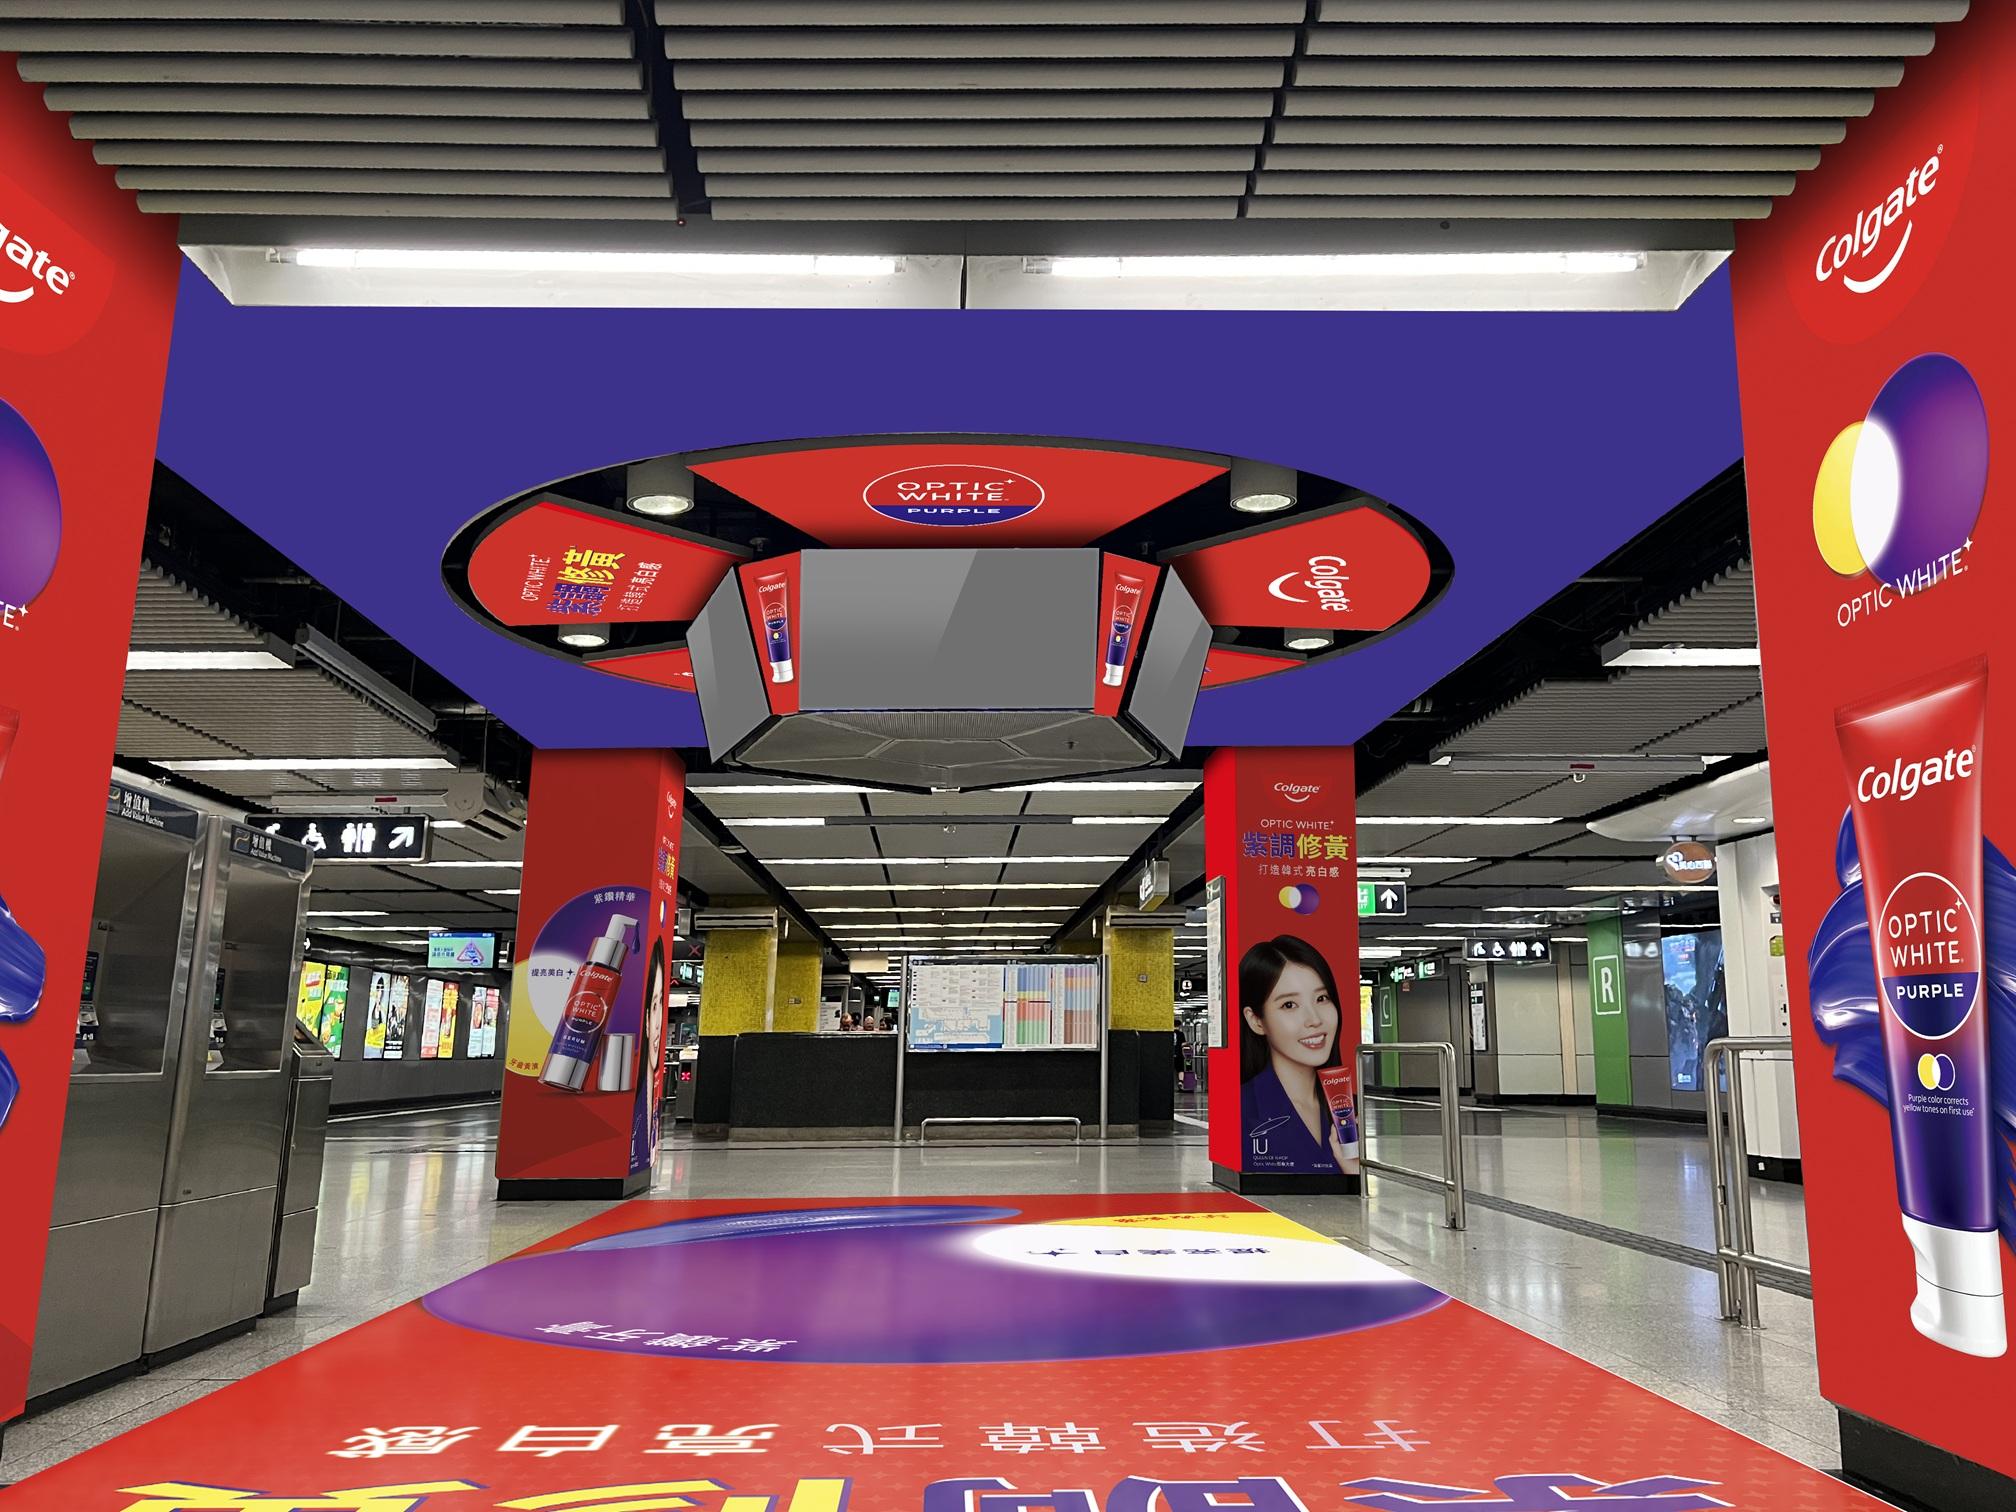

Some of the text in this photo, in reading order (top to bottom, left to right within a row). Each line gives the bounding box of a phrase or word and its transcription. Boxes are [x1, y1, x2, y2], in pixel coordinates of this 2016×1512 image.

[1815, 155, 1941, 282] Colgate
[896, 481, 1005, 492] OPTIC
[896, 491, 1005, 502] WHITE
[906, 507, 1001, 515] PURPLE
[758, 581, 786, 594] Colgate
[1115, 583, 1141, 595] Colgate
[1303, 554, 1351, 613] Colgate
[1837, 547, 1965, 628] OPTIC WHITE
[520, 580, 544, 602] OPTIC
[1857, 747, 1974, 803] Colgate
[1274, 782, 1320, 795] Colgate
[121, 807, 133, 818] Add
[1260, 818, 1330, 830] OPTIC WHITE
[1242, 831, 1349, 861] 紫調修黃
[1258, 863, 1341, 879] 打造韓式亮白感
[1888, 908, 1958, 939] OPTIC
[1889, 940, 1961, 968] WHITE
[579, 970, 614, 983] Colgate
[1600, 966, 1615, 1004] R
[1896, 983, 1964, 1000] PURPLE
[572, 1005, 598, 1018] WHITE
[573, 999, 599, 1011] OPTIC
[563, 1034, 587, 1045] SERUM
[1323, 1076, 1351, 1086] Colgate
[1908, 1093, 1969, 1106] Purple color corrects
[1902, 1103, 1922, 1113] yellow
[1922, 1104, 1939, 1114] tones
[1939, 1107, 1949, 1115] on
[1948, 1106, 1962, 1116] first
[1252, 1138, 1269, 1155] IU
[326, 1419, 1432, 1458] 打造韓式亮白感
